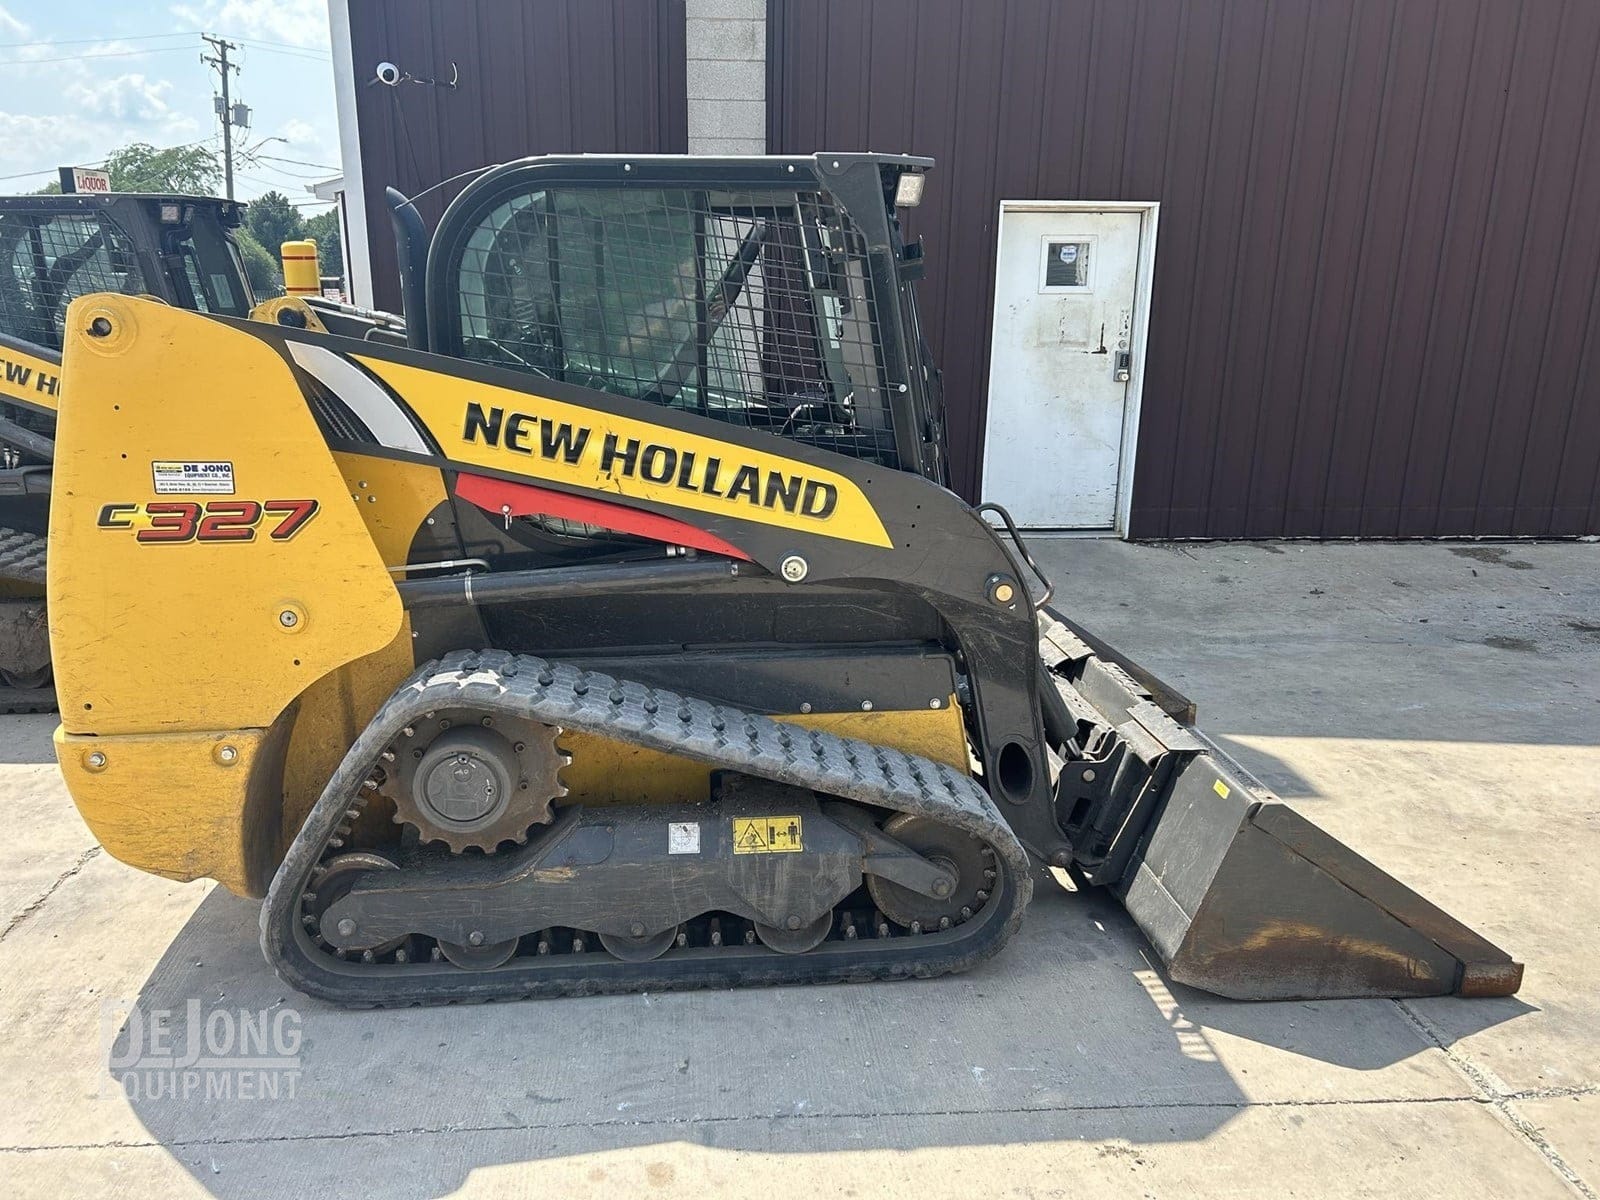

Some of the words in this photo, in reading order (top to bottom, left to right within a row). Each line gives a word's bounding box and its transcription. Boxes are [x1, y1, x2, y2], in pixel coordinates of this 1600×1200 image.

[77, 175, 108, 191] LIQUOR
[183, 464, 199, 472] DE
[201, 464, 231, 473] JONG
[462, 402, 590, 465] NEW
[600, 433, 839, 519] HOLLAND
[98, 499, 318, 543] C327
